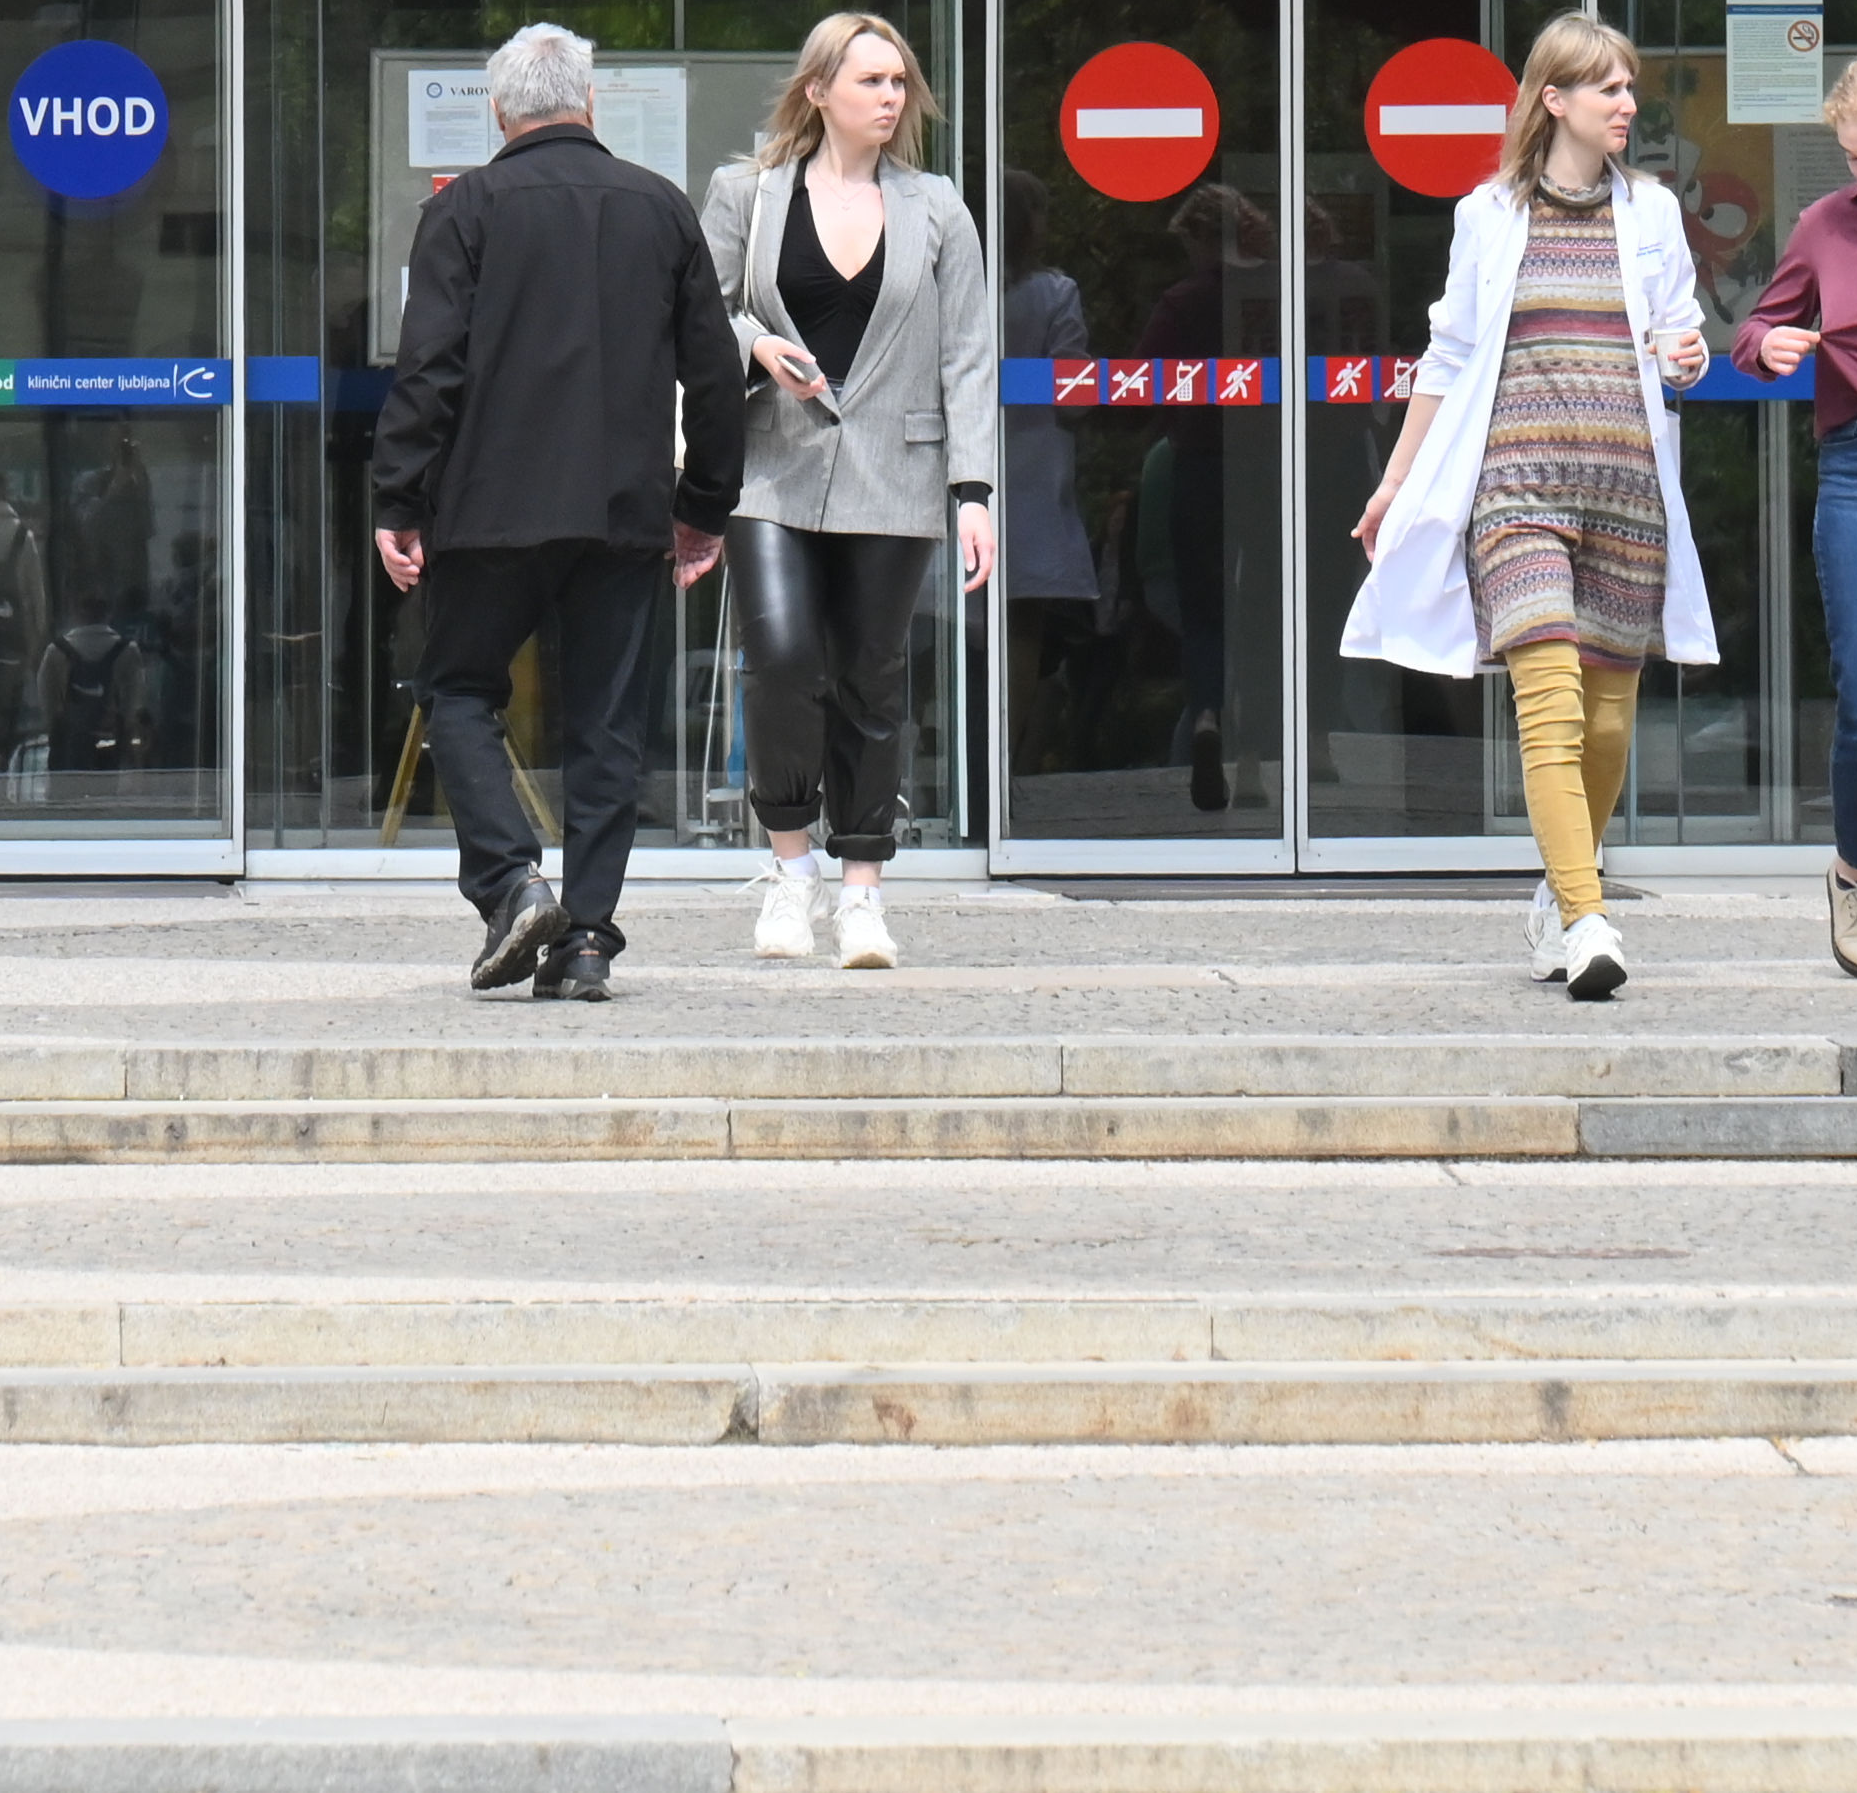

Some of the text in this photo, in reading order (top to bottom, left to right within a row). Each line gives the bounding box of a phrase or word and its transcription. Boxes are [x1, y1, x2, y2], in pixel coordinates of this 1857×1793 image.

[19, 96, 155, 136] VHOD
[28, 375, 70, 389] klinični
[75, 375, 113, 389] center
[118, 375, 170, 391] ljubljana
